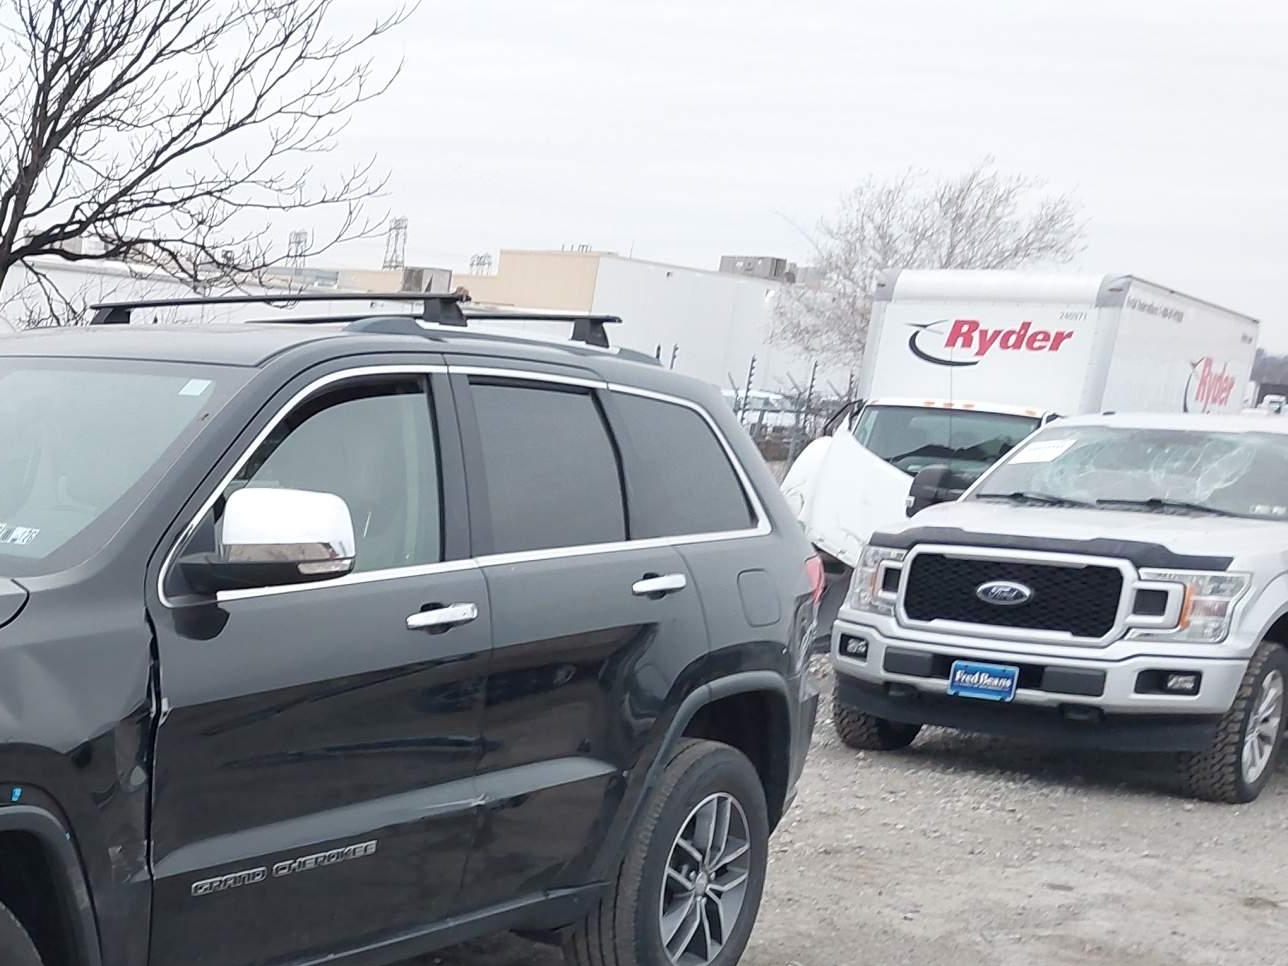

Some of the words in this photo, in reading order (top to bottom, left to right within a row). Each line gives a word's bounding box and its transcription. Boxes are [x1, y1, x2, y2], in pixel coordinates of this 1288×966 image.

[944, 319, 1074, 357] Ryder
[1195, 357, 1235, 413] Ryder
[191, 866, 268, 897] GRAND
[272, 840, 378, 878] CHEROKEE
